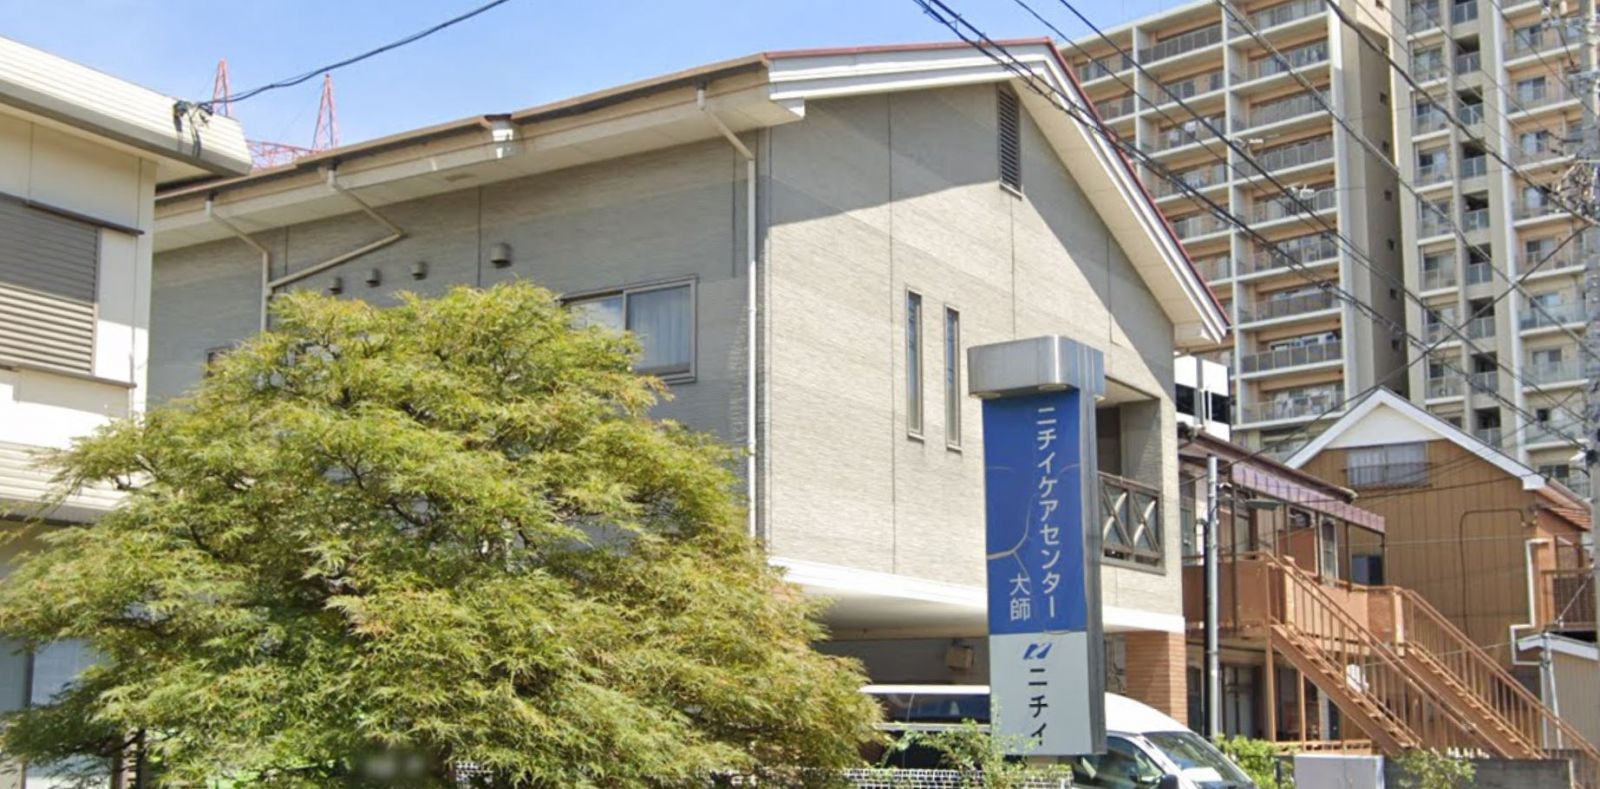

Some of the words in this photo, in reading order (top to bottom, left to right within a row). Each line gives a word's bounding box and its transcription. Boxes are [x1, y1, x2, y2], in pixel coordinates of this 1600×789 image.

[1036, 407, 1061, 618] ニチイケアセンター
[1009, 573, 1031, 621] 大師
[1028, 668, 1048, 746] ニチイ
